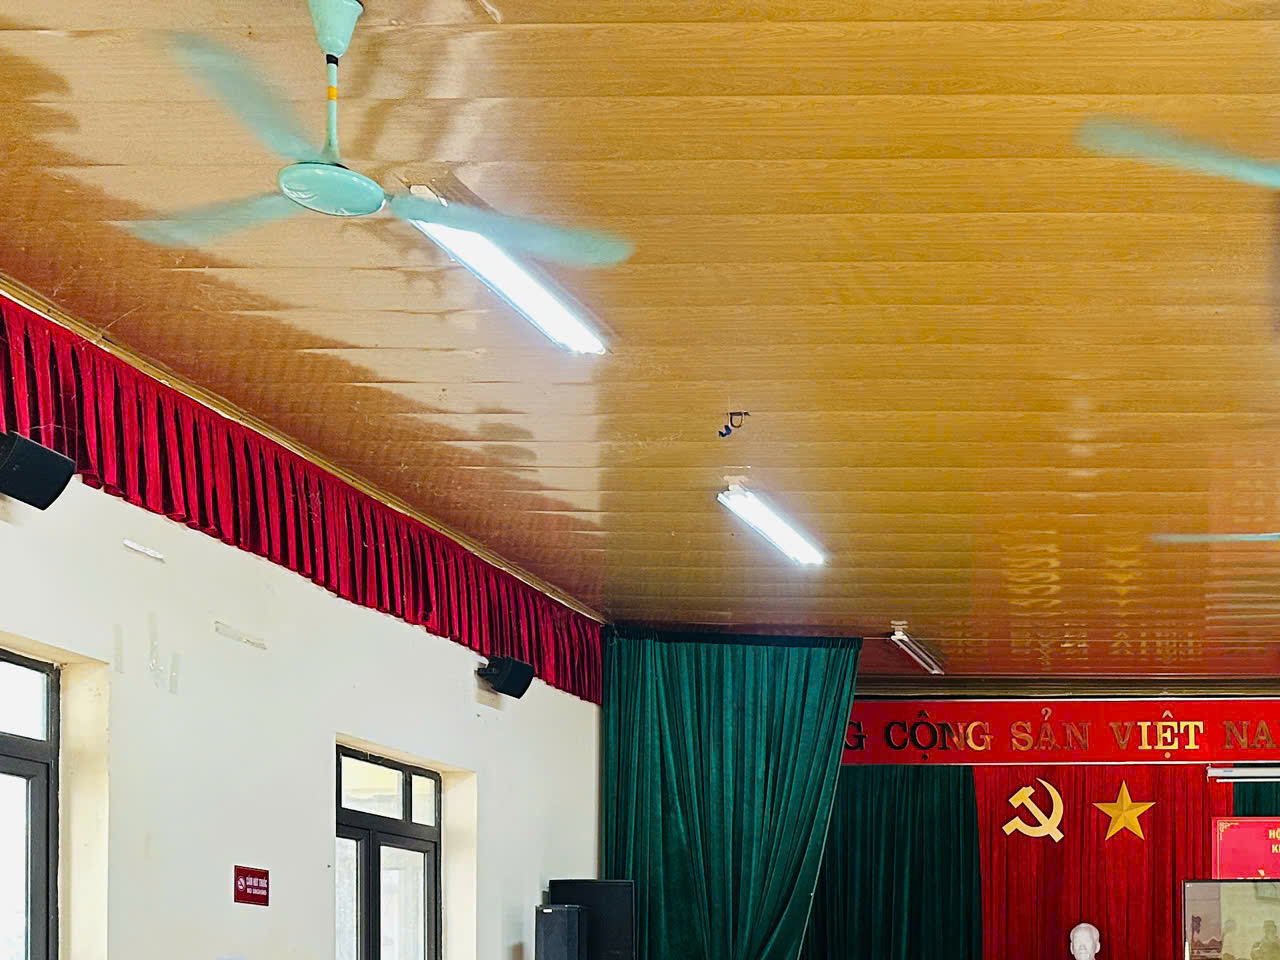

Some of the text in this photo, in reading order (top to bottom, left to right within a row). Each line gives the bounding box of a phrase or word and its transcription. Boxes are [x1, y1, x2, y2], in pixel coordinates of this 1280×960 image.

[885, 709, 993, 760] CỘNG
[1011, 707, 1090, 751] SẢN
[1109, 709, 1204, 758] VIỆT
